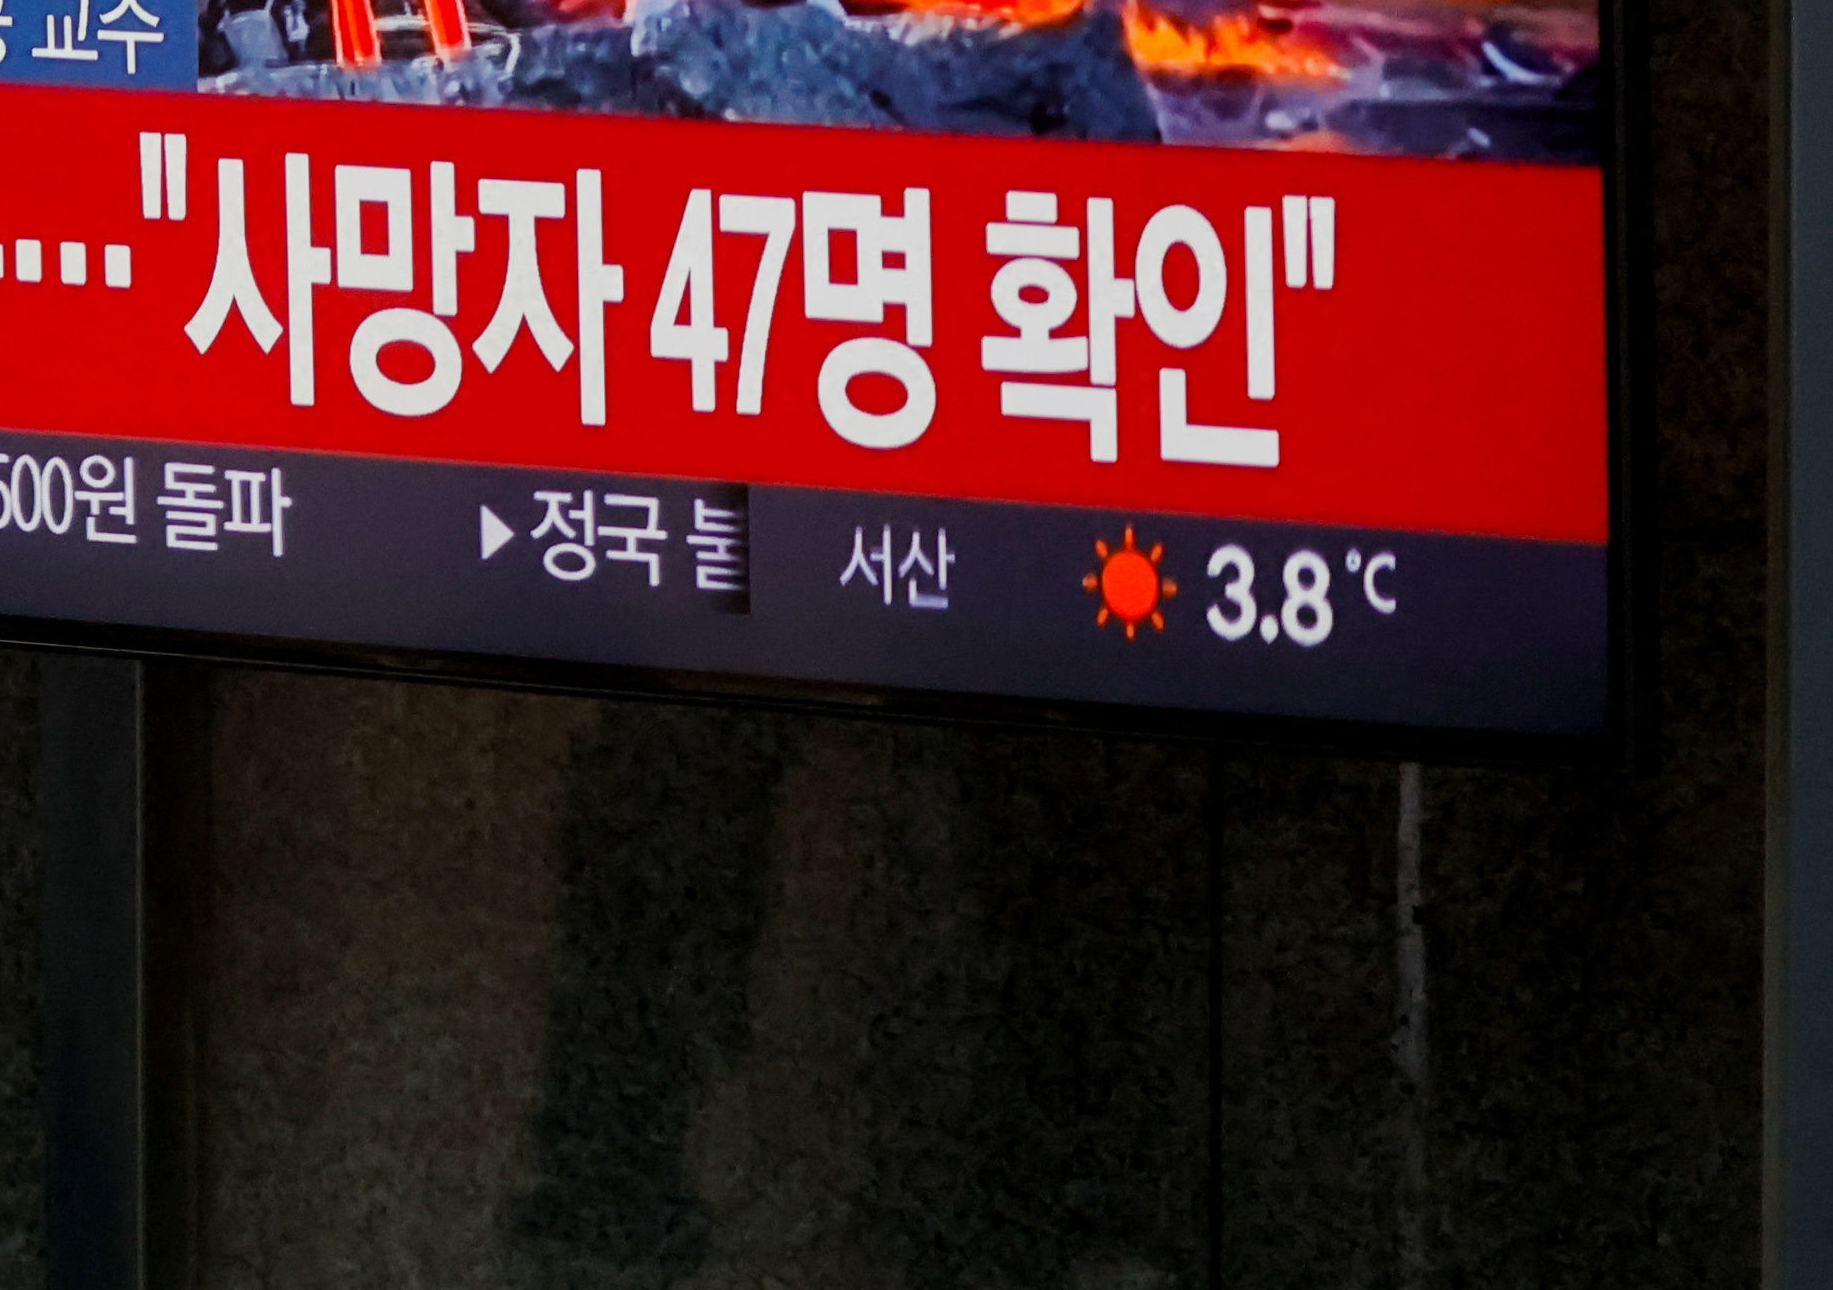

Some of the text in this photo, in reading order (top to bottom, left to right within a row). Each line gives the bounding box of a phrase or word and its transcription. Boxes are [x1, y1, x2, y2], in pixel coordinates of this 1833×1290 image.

[650, 186, 937, 450] 47명
[981, 189, 1334, 468] 확인"
[157, 461, 292, 557] 돌파
[530, 490, 667, 588] 정국
[840, 524, 956, 609] 서산
